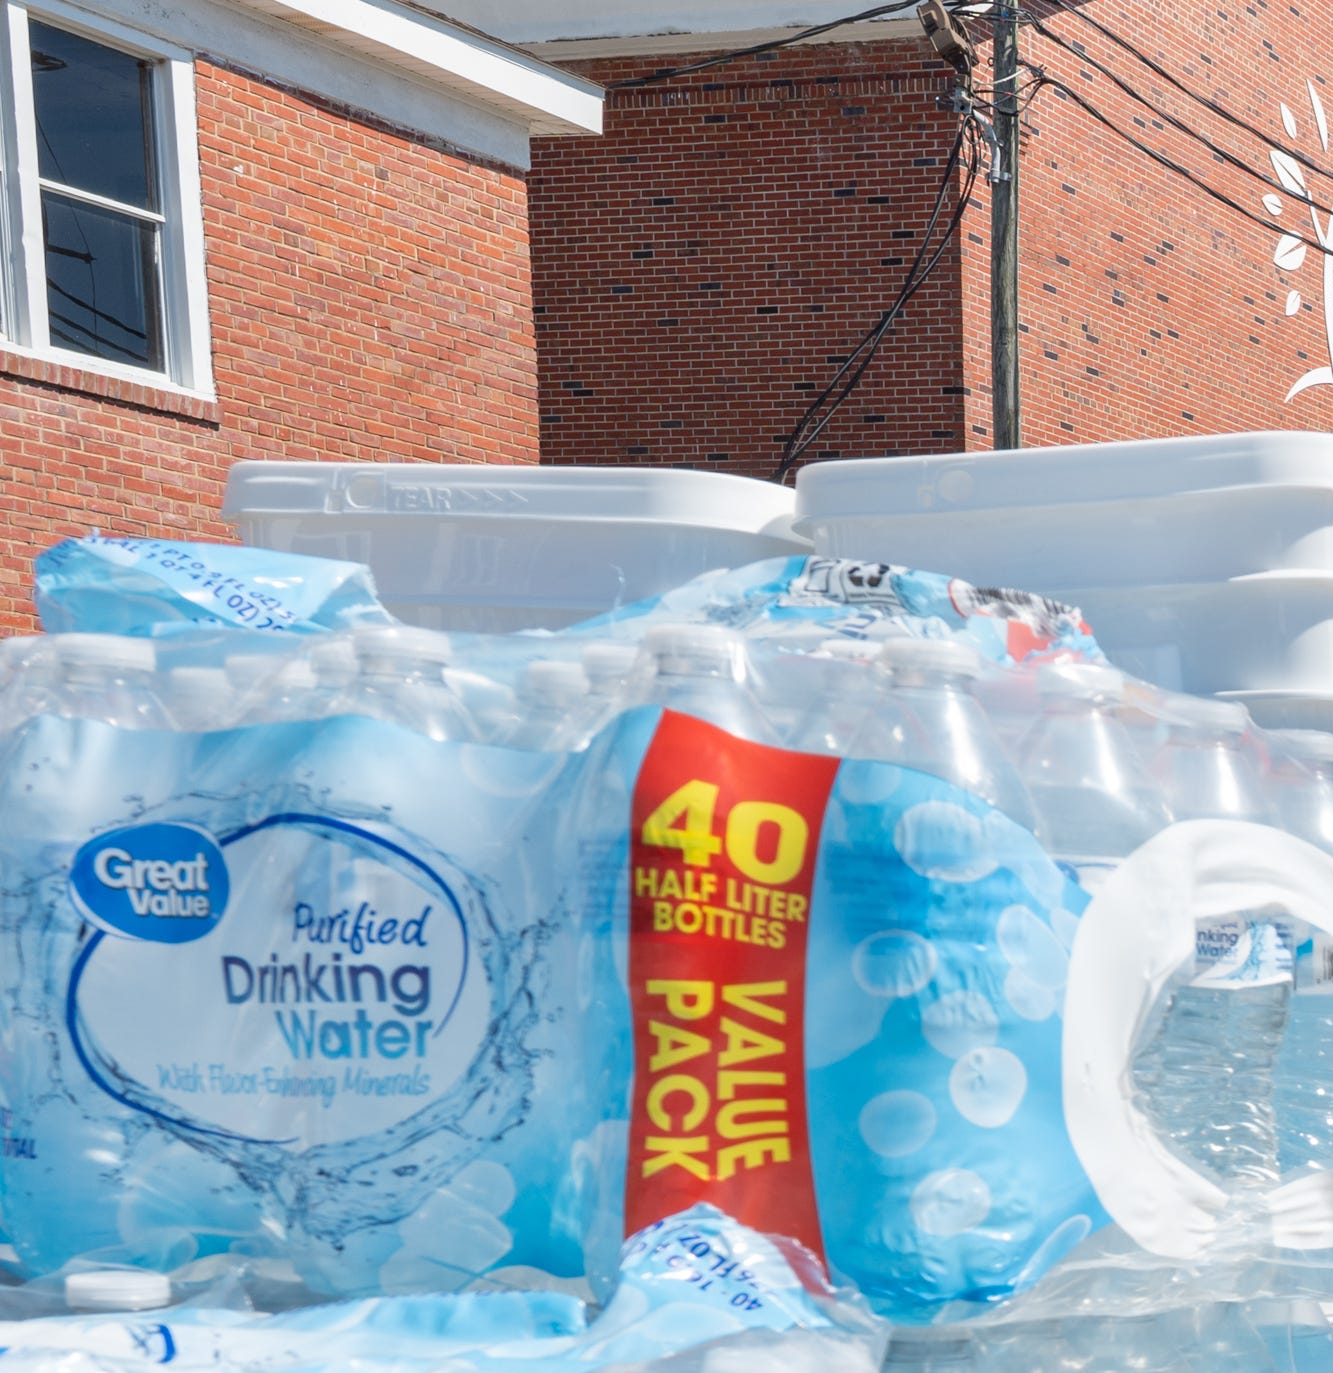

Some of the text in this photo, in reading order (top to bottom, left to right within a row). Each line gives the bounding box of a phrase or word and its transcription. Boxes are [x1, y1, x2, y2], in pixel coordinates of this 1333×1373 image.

[641, 778, 809, 885] 40
[94, 847, 209, 891] Great
[635, 867, 718, 902] HALF
[726, 877, 808, 922] LITER
[126, 888, 210, 917] Value
[292, 901, 433, 955] Purified
[653, 901, 787, 949] BOTTLES
[221, 952, 431, 1017] Drinking
[275, 1008, 433, 1060] Water
[156, 1063, 206, 1093] With
[343, 1063, 432, 1098] Minerals
[642, 979, 715, 1182] PACK
[715, 979, 791, 1182] VALUE
